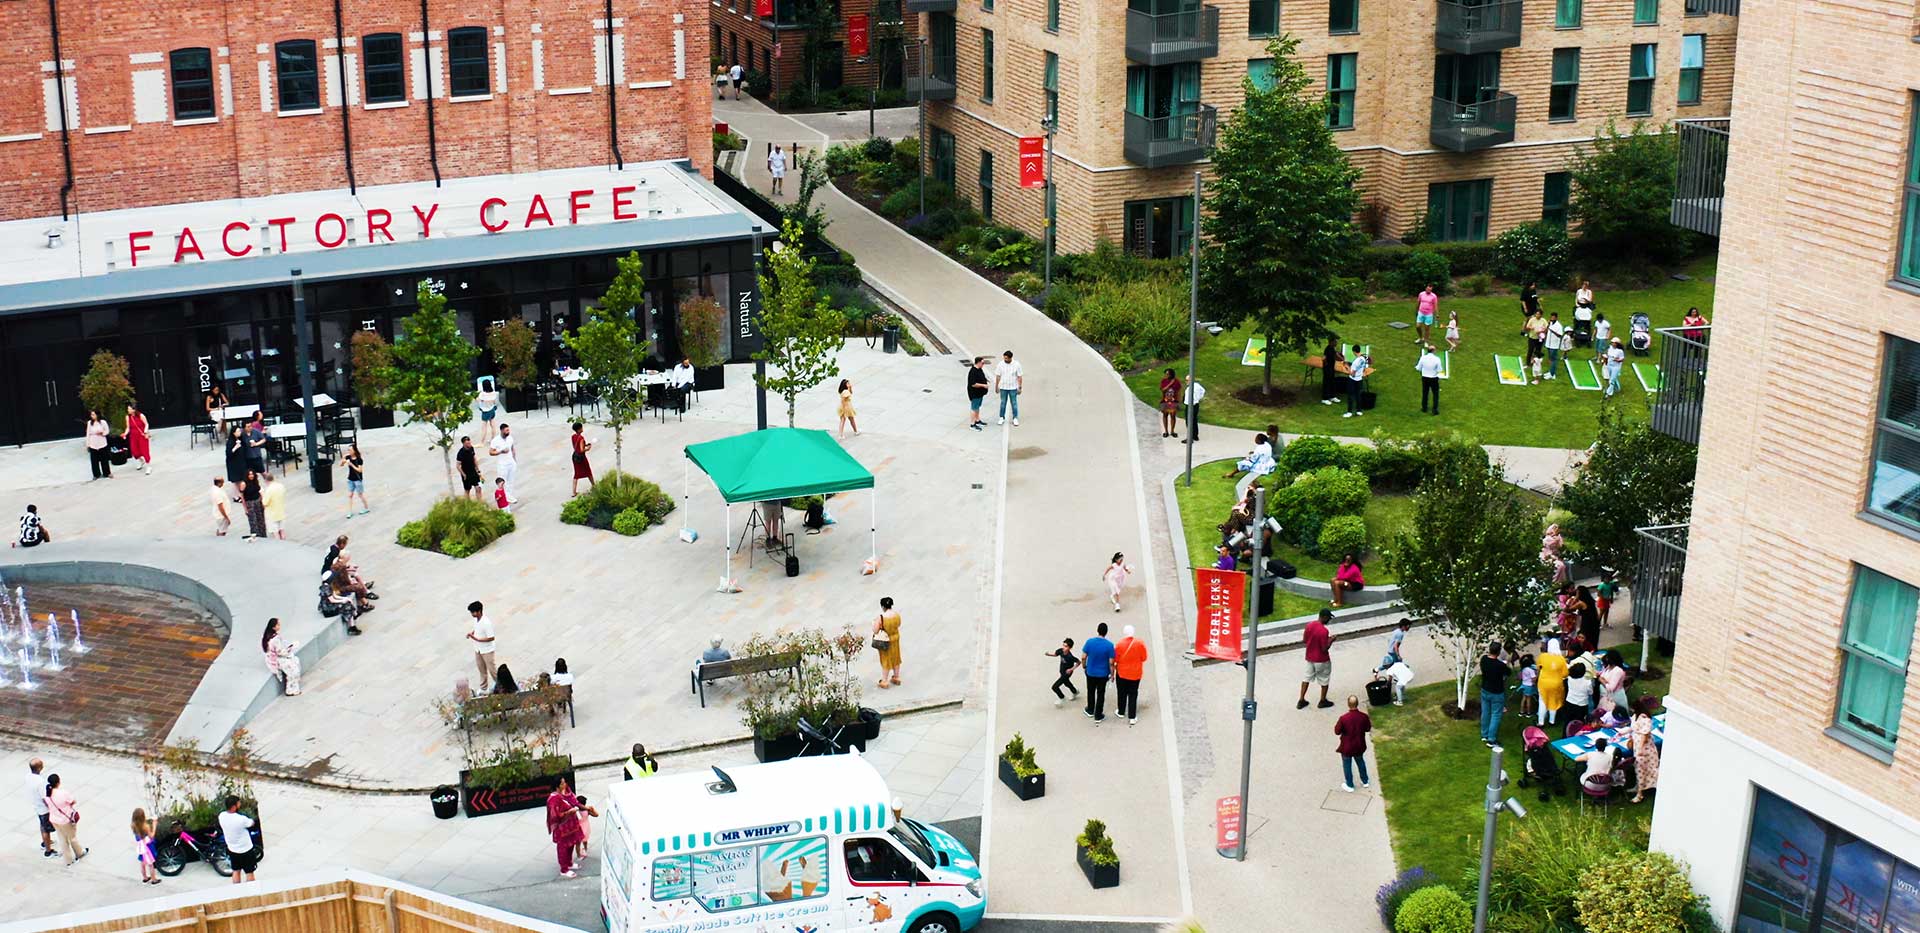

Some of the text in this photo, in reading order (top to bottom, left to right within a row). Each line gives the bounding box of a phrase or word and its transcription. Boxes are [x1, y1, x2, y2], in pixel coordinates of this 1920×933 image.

[129, 186, 638, 266] FACTORY CAFE
[740, 291, 752, 338] Natural
[198, 355, 212, 392] Local
[1209, 577, 1221, 648] HORLICKS
[1222, 589, 1230, 635] QUARTER
[722, 824, 790, 841] MR WHIPPY
[694, 920, 730, 931] Made
[735, 912, 760, 924] Soft
[766, 911, 784, 920] Ice
[788, 905, 829, 917] Cream
